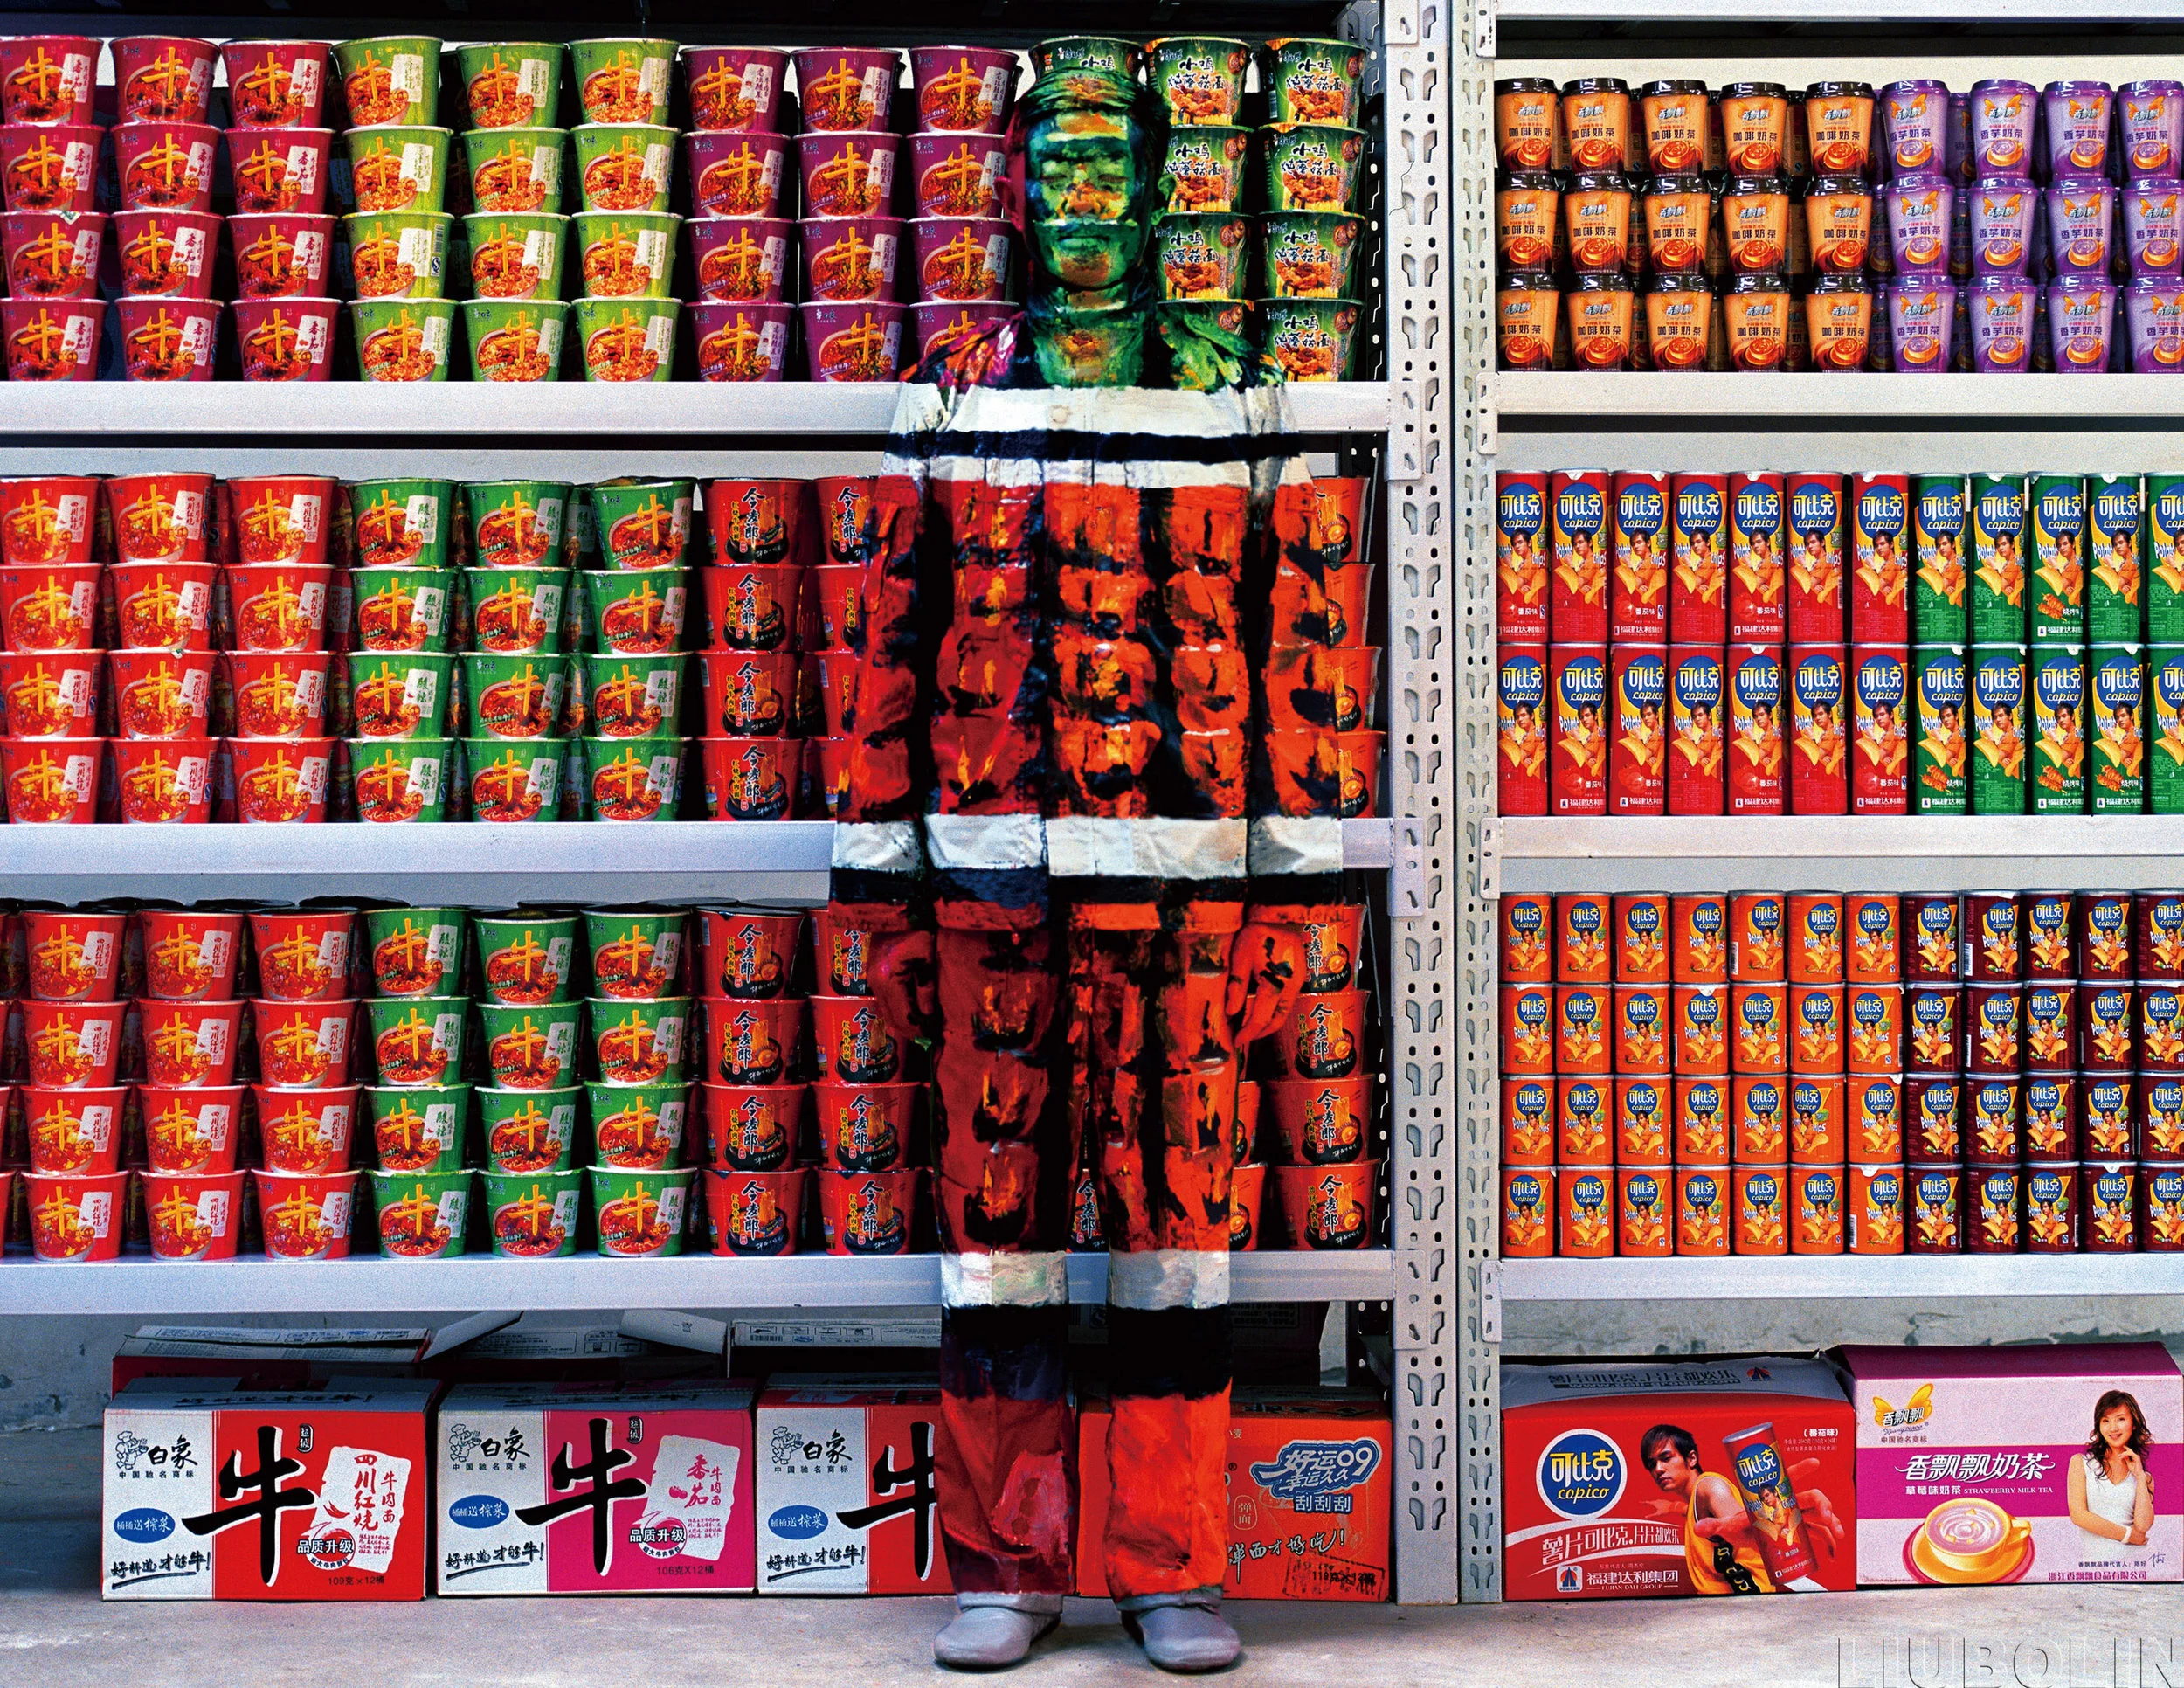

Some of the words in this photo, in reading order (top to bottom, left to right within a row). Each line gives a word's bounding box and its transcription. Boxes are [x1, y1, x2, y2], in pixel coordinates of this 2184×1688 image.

[15, 46, 56, 100] 牛
[142, 46, 189, 100] 牛
[244, 52, 289, 105] 牛
[352, 50, 390, 101] 牛
[480, 52, 520, 104] 牛
[1178, 57, 1214, 74] 小鸡
[1295, 58, 1329, 74] 小鸡
[698, 56, 742, 108] 牛
[816, 58, 861, 110] 牛
[935, 58, 983, 110] 牛
[1509, 128, 1551, 138] 咖啡奶茶
[1572, 128, 1614, 139] 咖啡奶茶
[1652, 130, 1695, 141] 咖啡奶茶
[1733, 131, 1777, 142] 咖啡奶茶
[1816, 131, 1860, 142] 咖啡奶茶
[1890, 129, 1931, 141] 香芋奶茶
[1981, 129, 2023, 140] 香芋奶茶
[2064, 129, 2105, 140] 香芋奶茶
[2126, 129, 2168, 141] 香芋奶茶
[1176, 144, 1210, 161] 小鸡
[1293, 142, 1328, 160] 小鸡
[1572, 227, 1616, 238] 咖啡奶茶
[1653, 228, 1696, 239] 咖啡奶茶
[1732, 228, 1776, 239] 咖啡奶茶
[1898, 228, 1940, 238] 香芋奶茶
[1980, 228, 2022, 238] 香芋奶茶
[2061, 228, 2104, 239] 香芋奶茶
[1284, 315, 1318, 333] 小鸡
[1577, 325, 1621, 336] 咖啡奶茶
[1658, 326, 1701, 336] 咖啡奶茶
[1897, 326, 1939, 336] 香芋奶茶
[2061, 326, 2103, 336] 香芋奶茶
[12, 489, 59, 541] 牛
[127, 484, 175, 537] 牛
[245, 489, 291, 540] 牛
[363, 490, 407, 543] 牛
[490, 491, 536, 545] 牛
[626, 495, 672, 545] 牛
[743, 487, 767, 549] 今麦郎
[838, 487, 860, 546] 今麦郎
[1501, 495, 1540, 521] 可比克
[1621, 495, 1662, 521] 可比克
[1678, 495, 1719, 521] 可比克
[1923, 495, 1963, 521] 可比克
[739, 573, 763, 633] 今麦郎
[1679, 668, 1719, 693] 可比克
[1862, 668, 1902, 694] 可比克
[1980, 668, 2022, 694] 可比克
[743, 746, 765, 806] 今麦郎
[1514, 908, 1540, 923] 可比克
[1631, 908, 1657, 923] 可比克
[1924, 907, 1950, 922] 可比克
[38, 924, 85, 975] 牛
[156, 924, 203, 975] 牛
[274, 924, 321, 976] 牛
[384, 918, 429, 970] 牛
[500, 930, 546, 982] 牛
[612, 925, 659, 977] 牛
[738, 924, 762, 983] 今麦郎
[1310, 1003, 1332, 1063] 今麦郎
[741, 1096, 765, 1155] 今麦郎
[850, 1094, 875, 1153] 今麦郎
[1317, 1089, 1339, 1149] 今麦郎
[1883, 1408, 1925, 1427] 香飘飘
[148, 1434, 198, 1469] 白象
[481, 1426, 530, 1461] 白象
[803, 1429, 853, 1464] 白象
[119, 1470, 194, 1479] 中国驰名商标
[453, 1463, 527, 1471] 中国驰名商标
[774, 1465, 848, 1474] 中国驰名商标
[1549, 1449, 1614, 1487] 可比克
[1738, 1449, 1777, 1478] 可比克
[1895, 1453, 2056, 1483] 香飘飘奶茶
[354, 1454, 378, 1531] 四川红烧
[684, 1454, 709, 1508] 番茄
[710, 1466, 722, 1506] 牛肉面
[1279, 1470, 1349, 1491] 幸运久久
[1748, 1472, 1778, 1487] copico
[1905, 1486, 1961, 1495] 草莓味奶茶
[182, 1426, 316, 1587] 牛
[381, 1471, 397, 1523] 牛肉面
[515, 1417, 646, 1576] 牛
[836, 1421, 937, 1581] 牛
[1295, 1495, 1351, 1512] 刮刮刮
[1557, 1484, 1609, 1504] copico
[297, 1539, 354, 1554] 品质升级
[629, 1528, 686, 1543] 品质升级
[1586, 1570, 1678, 1585] 福建达利集团
[2049, 1571, 2147, 1581] 浙江香飘飘食品有限公司
